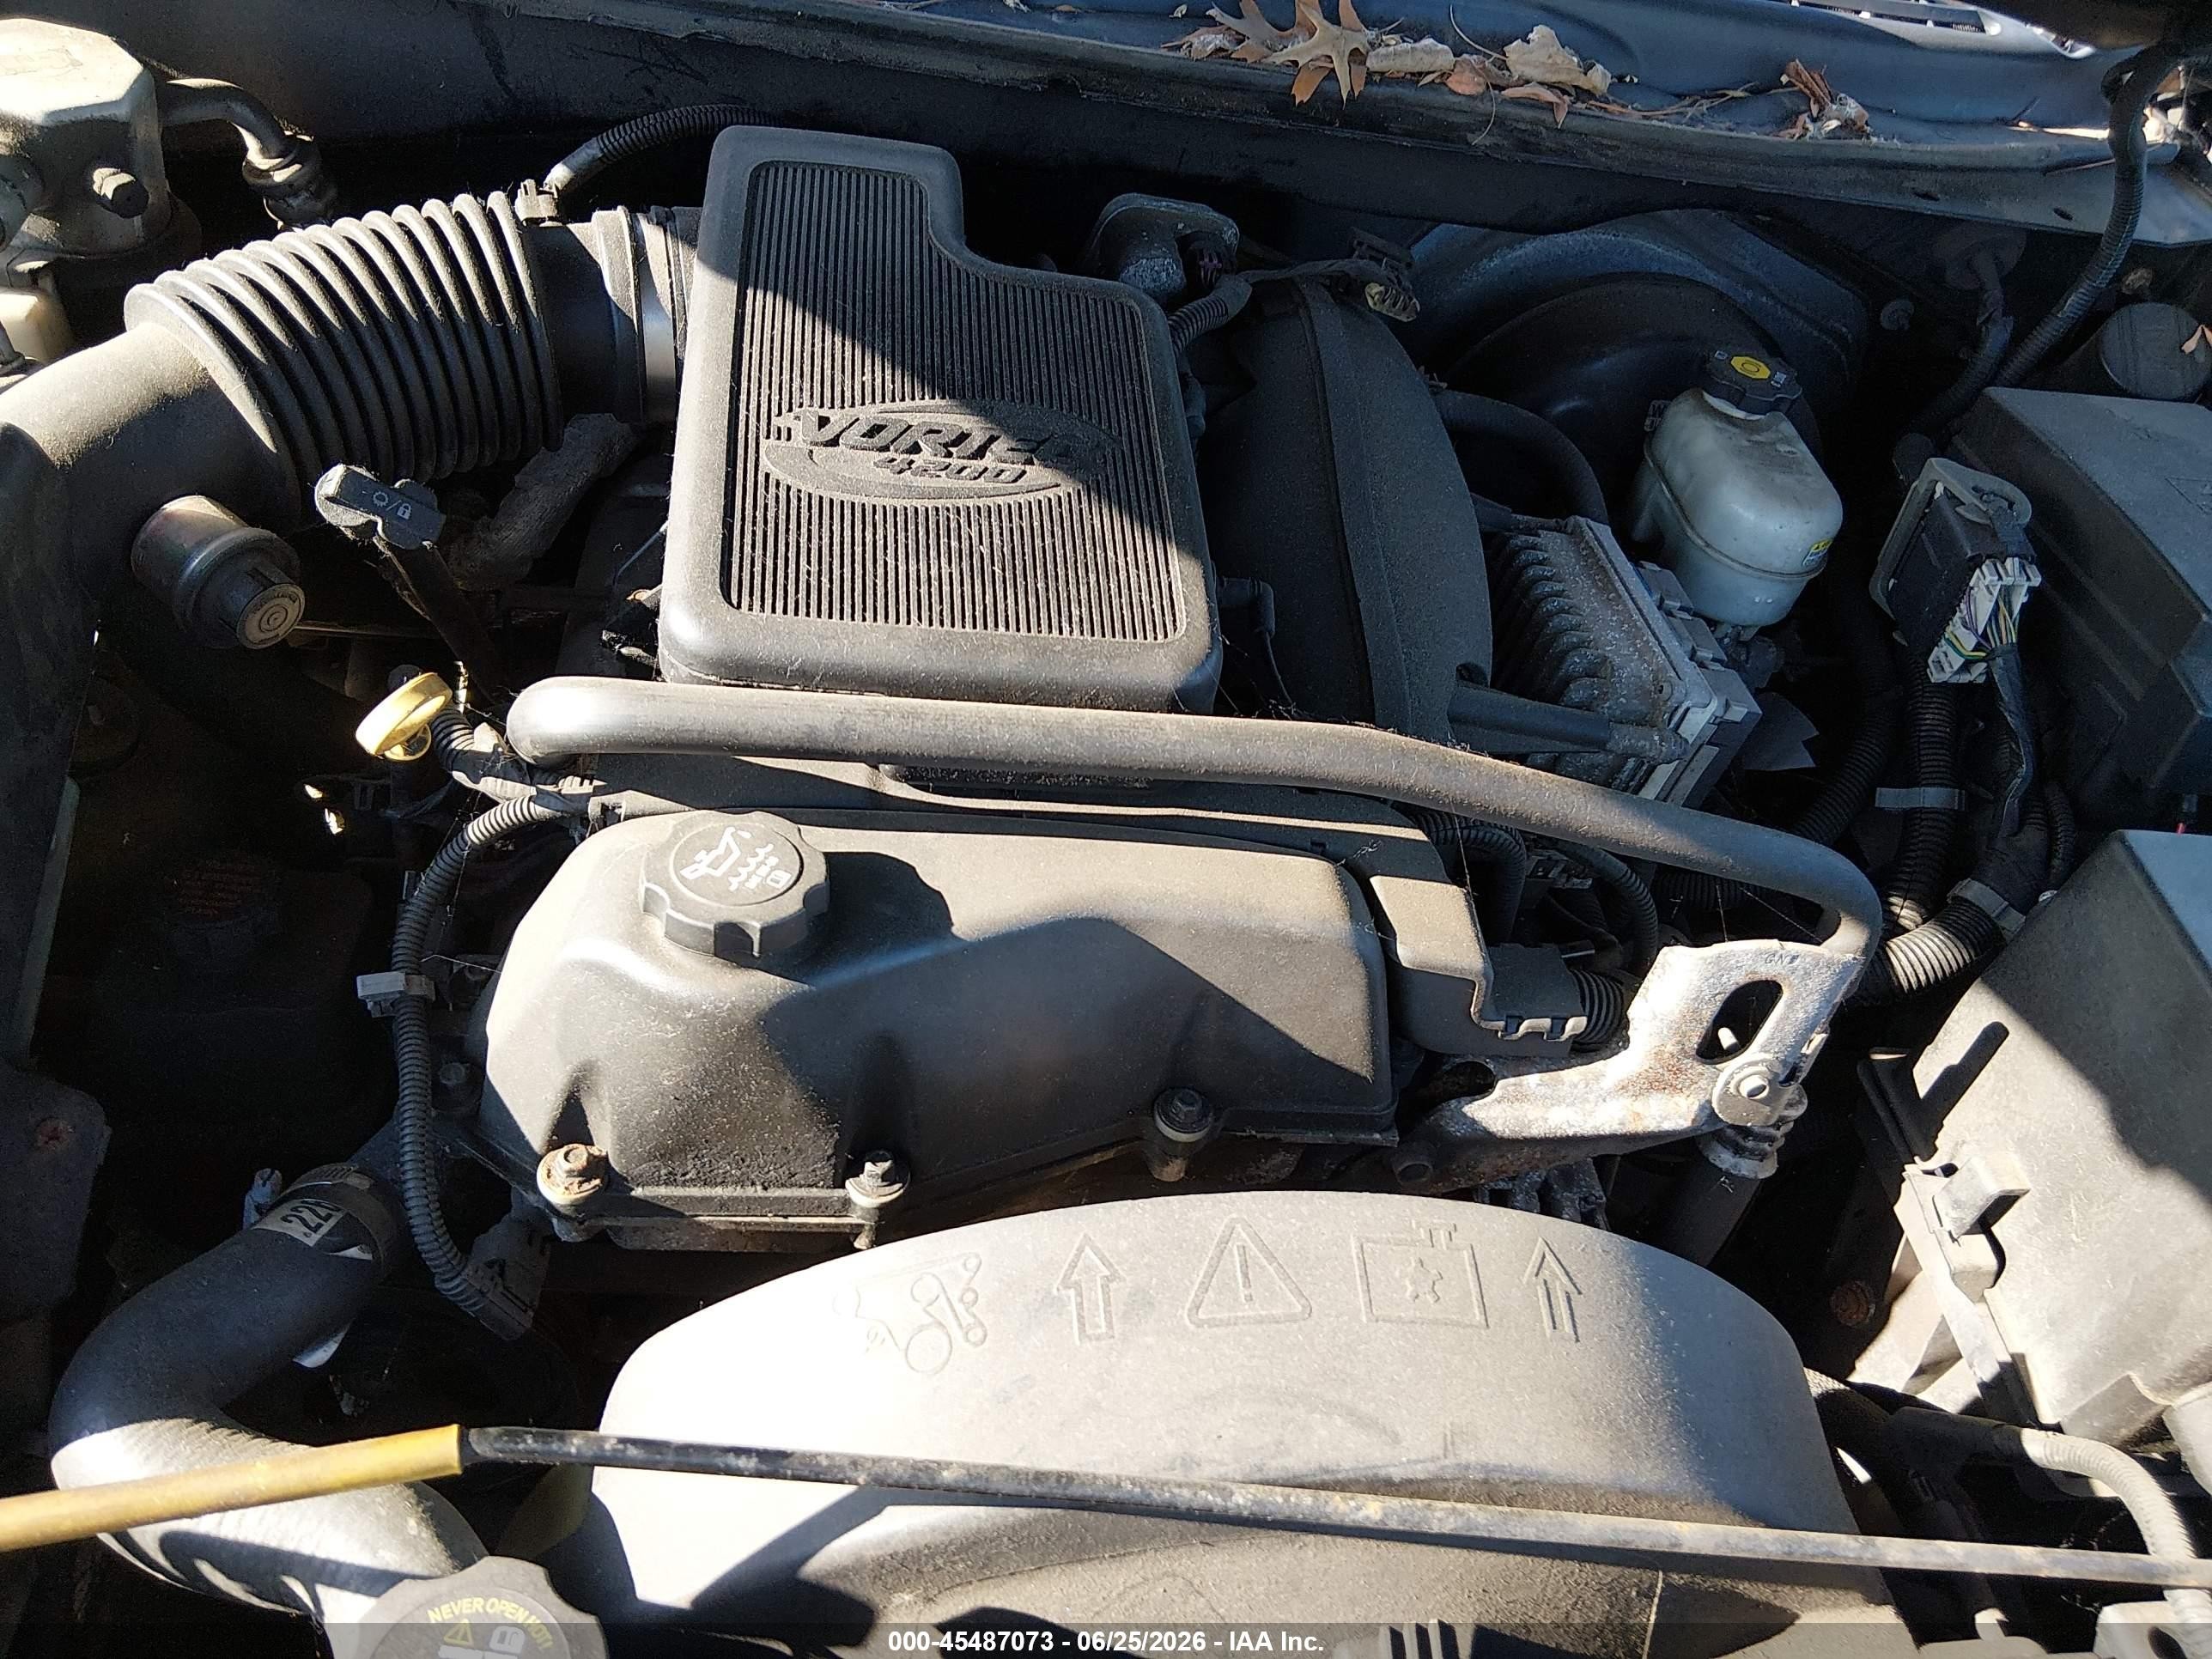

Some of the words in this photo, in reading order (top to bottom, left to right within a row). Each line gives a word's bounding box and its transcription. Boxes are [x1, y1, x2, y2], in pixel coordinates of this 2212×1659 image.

[872, 456, 1027, 484] 4200
[427, 1596, 486, 1624] NEVER
[485, 1597, 530, 1624] OPEN
